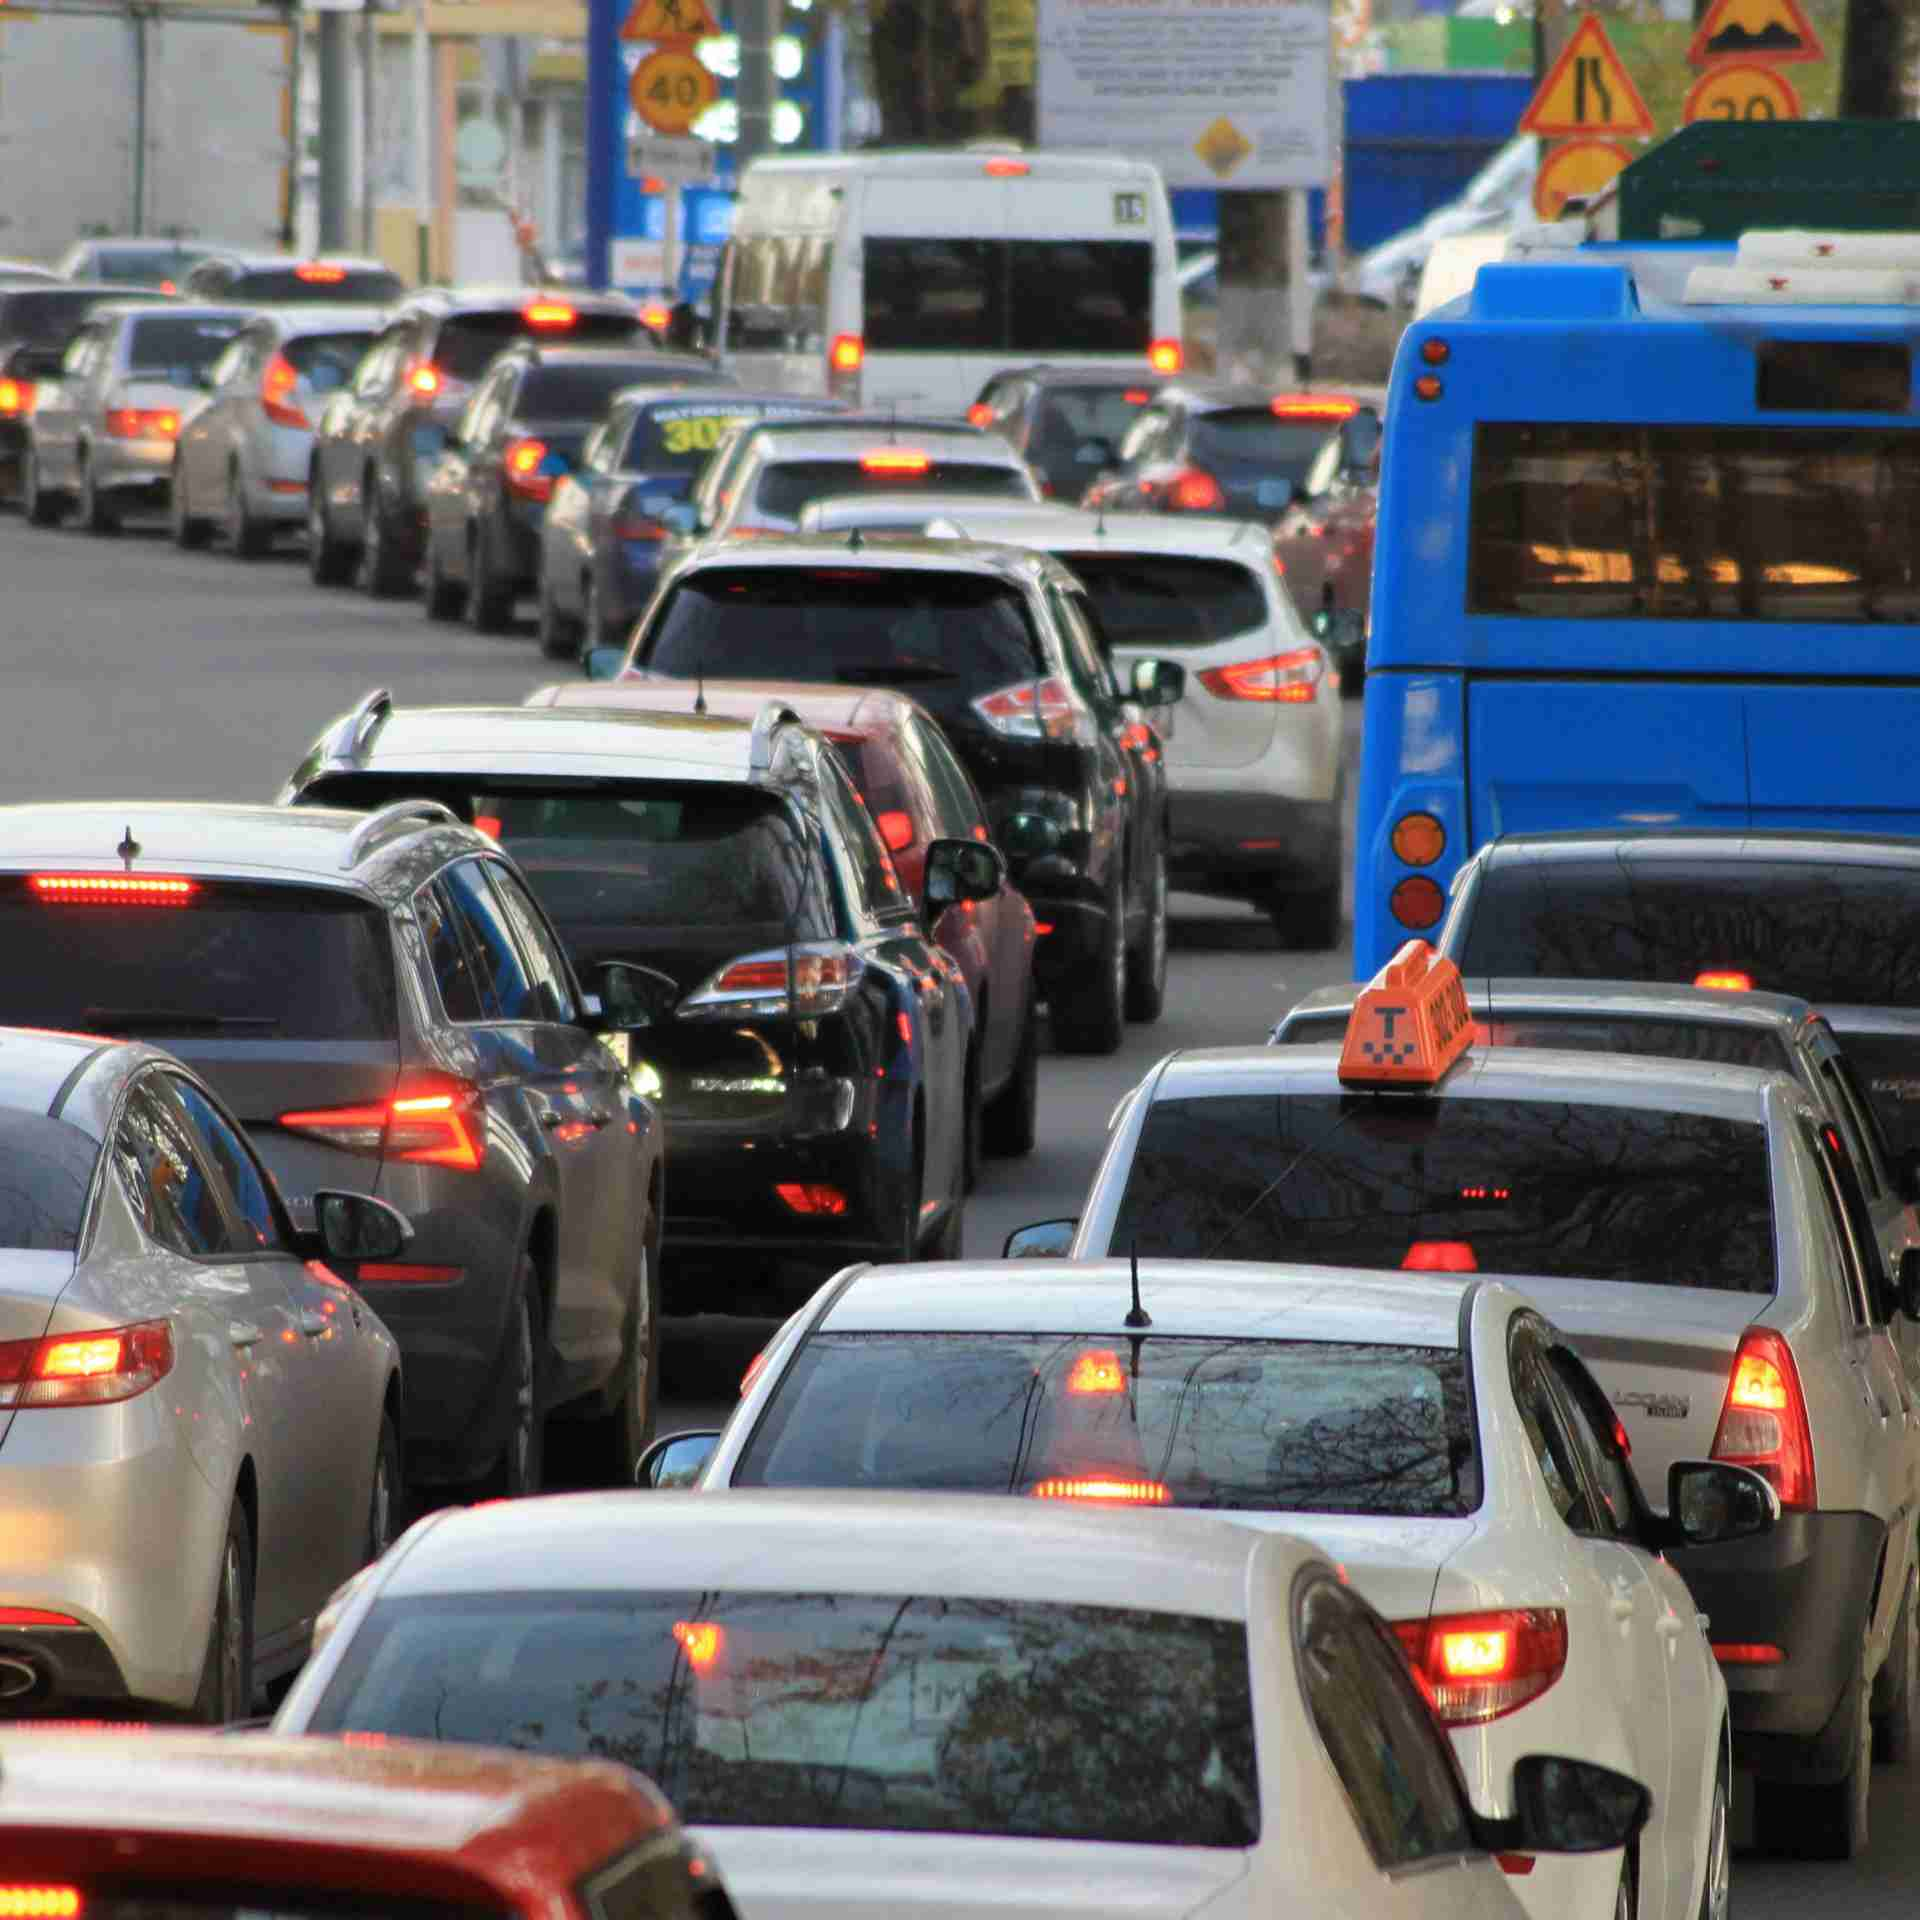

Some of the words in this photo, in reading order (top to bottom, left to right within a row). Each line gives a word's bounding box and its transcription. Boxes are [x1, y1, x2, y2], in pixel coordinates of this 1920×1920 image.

[647, 75, 700, 109] 40
[1374, 1007, 1406, 1039] Т
[1615, 1390, 1690, 1410] LOGAN
